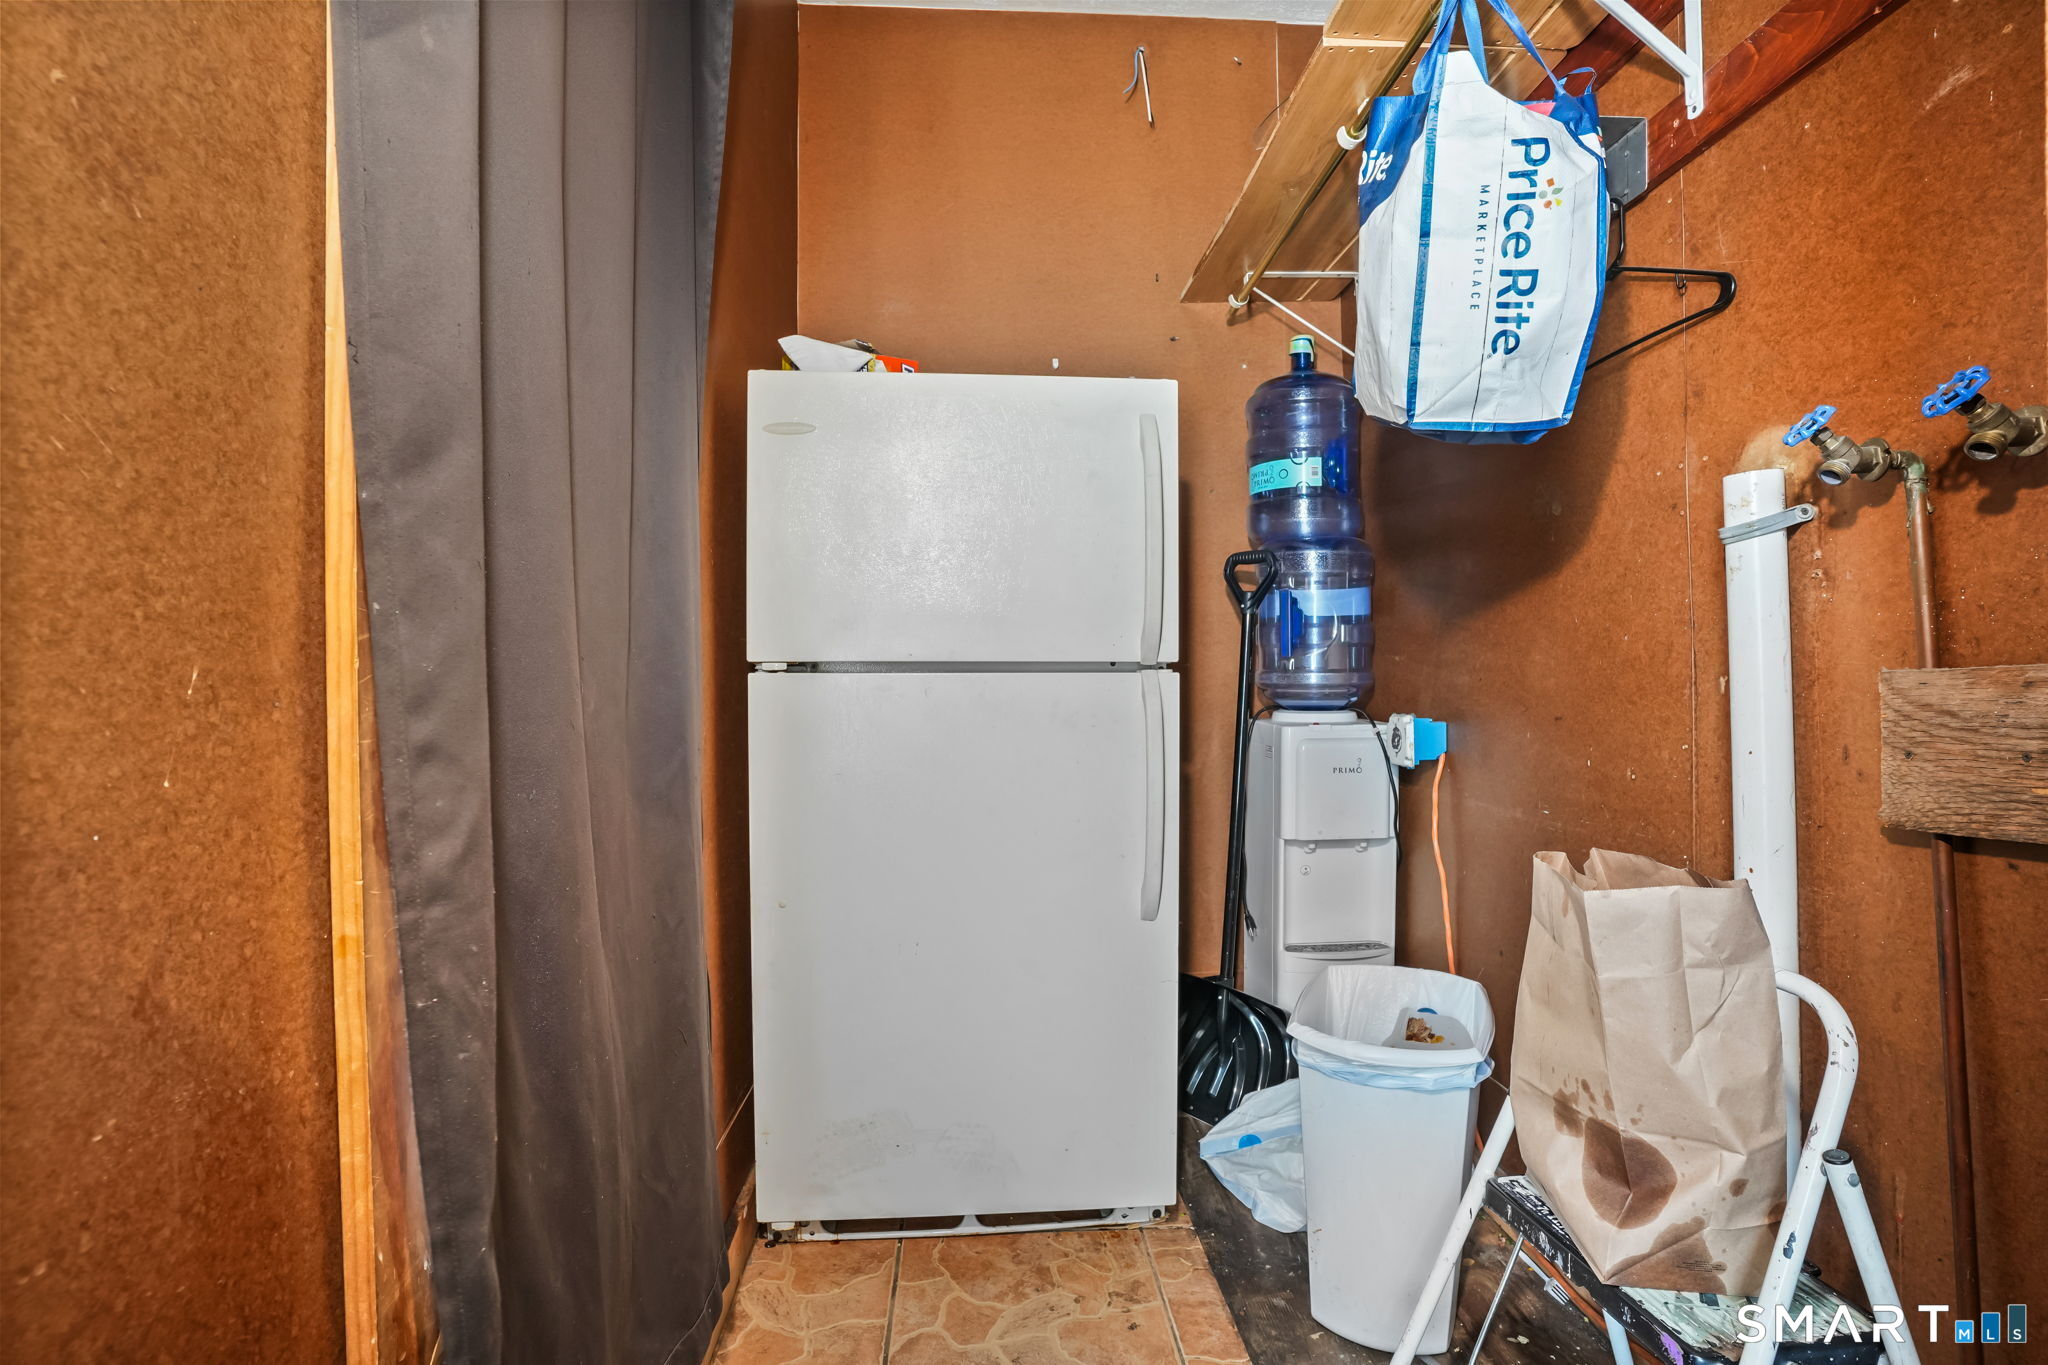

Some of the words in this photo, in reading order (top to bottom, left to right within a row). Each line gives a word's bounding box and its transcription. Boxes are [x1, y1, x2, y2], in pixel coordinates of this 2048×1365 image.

[1470, 184, 1491, 310] MARKETPLACE
[1501, 137, 1550, 259] Price
[1491, 268, 1539, 356] Rite
[1332, 766, 1363, 774] PRIMO
